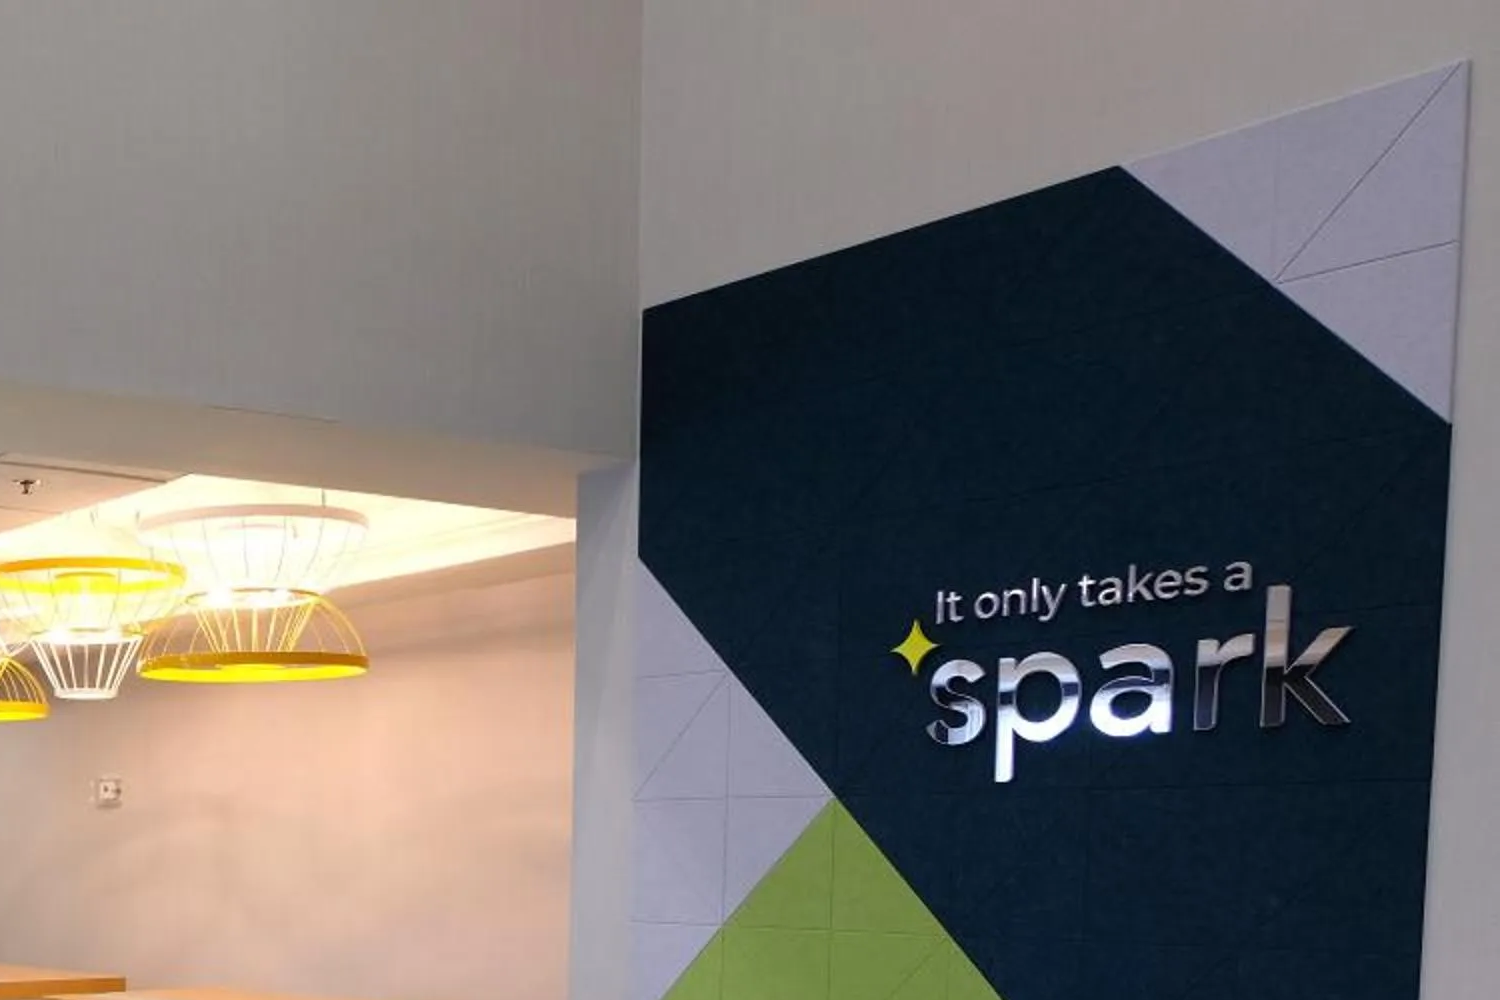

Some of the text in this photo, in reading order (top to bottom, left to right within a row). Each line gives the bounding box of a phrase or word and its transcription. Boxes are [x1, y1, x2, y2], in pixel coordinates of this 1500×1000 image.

[935, 560, 1253, 624] It only takes a
[926, 584, 1354, 783] spark
